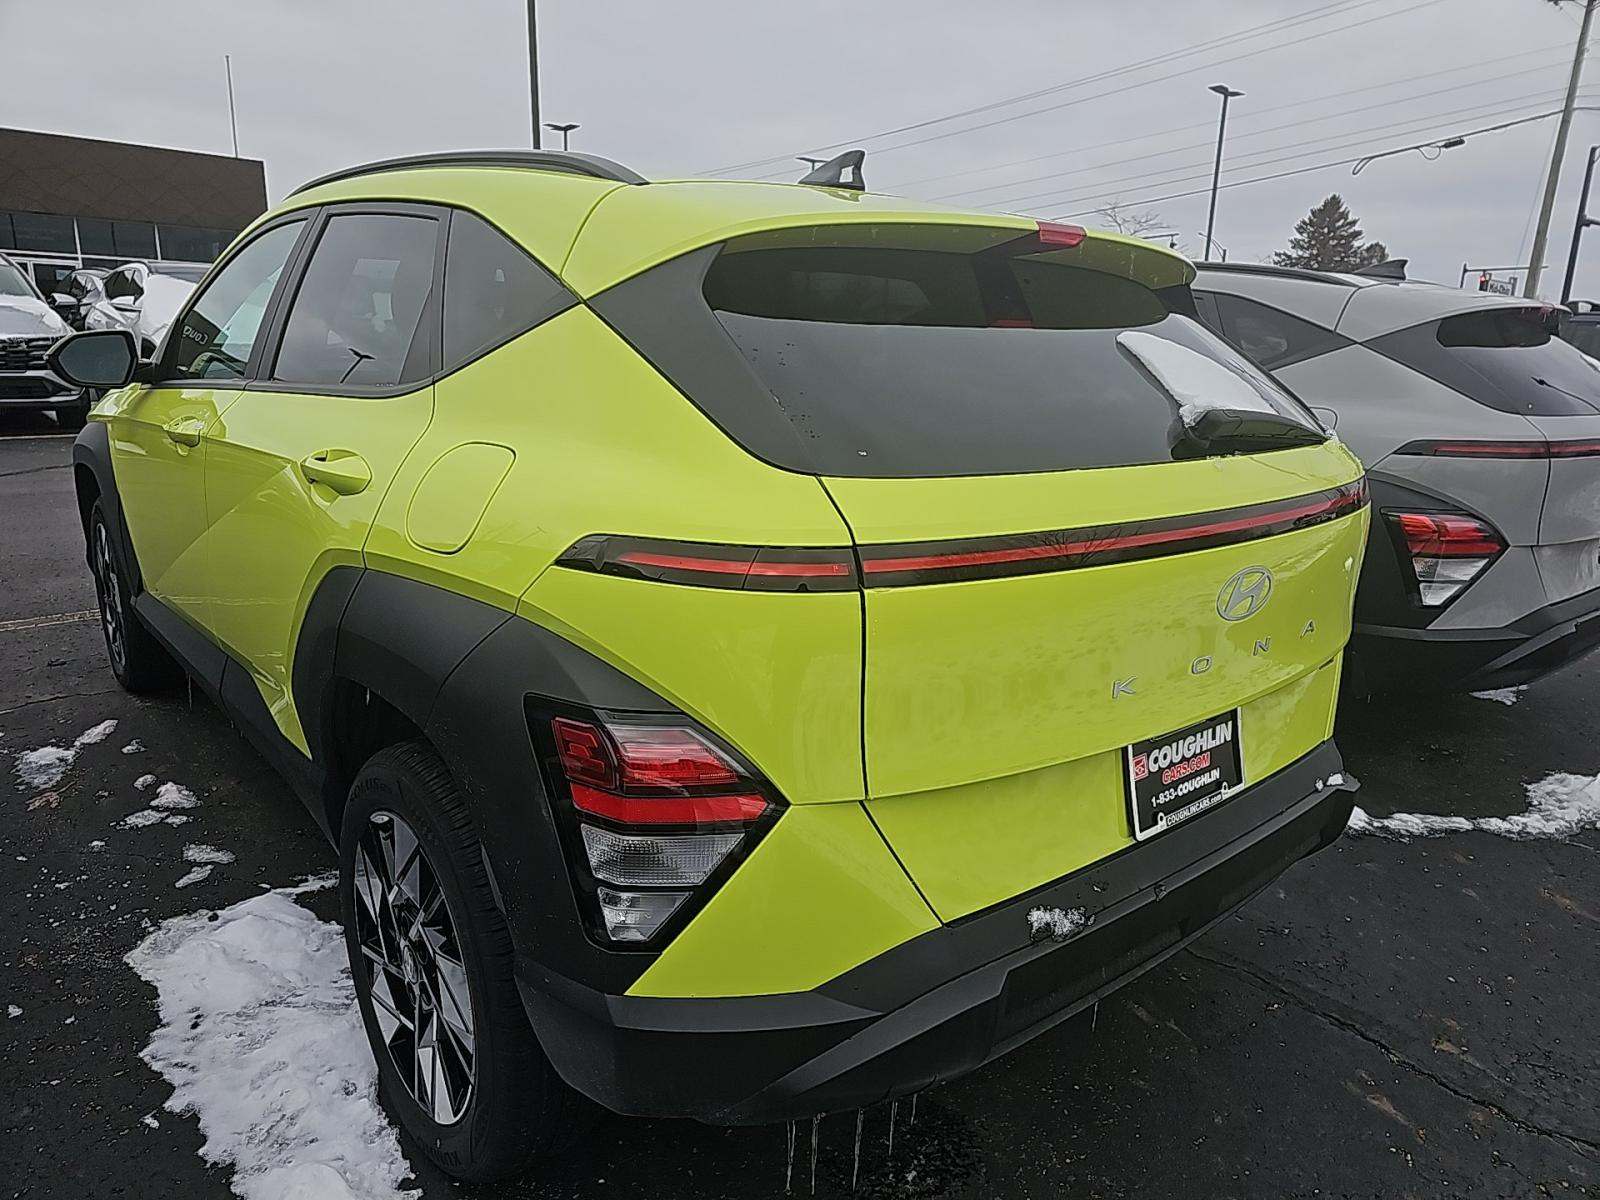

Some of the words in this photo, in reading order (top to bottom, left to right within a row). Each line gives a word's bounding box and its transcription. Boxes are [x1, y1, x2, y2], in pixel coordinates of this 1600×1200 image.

[1112, 619, 1316, 699] KONA
[1148, 720, 1233, 773] COUGHLIN
[1151, 767, 1220, 807] 1-833-COUGHLIN
[1162, 751, 1211, 785] CARS.COM
[1166, 793, 1222, 826] COUGHLINCARS.com
